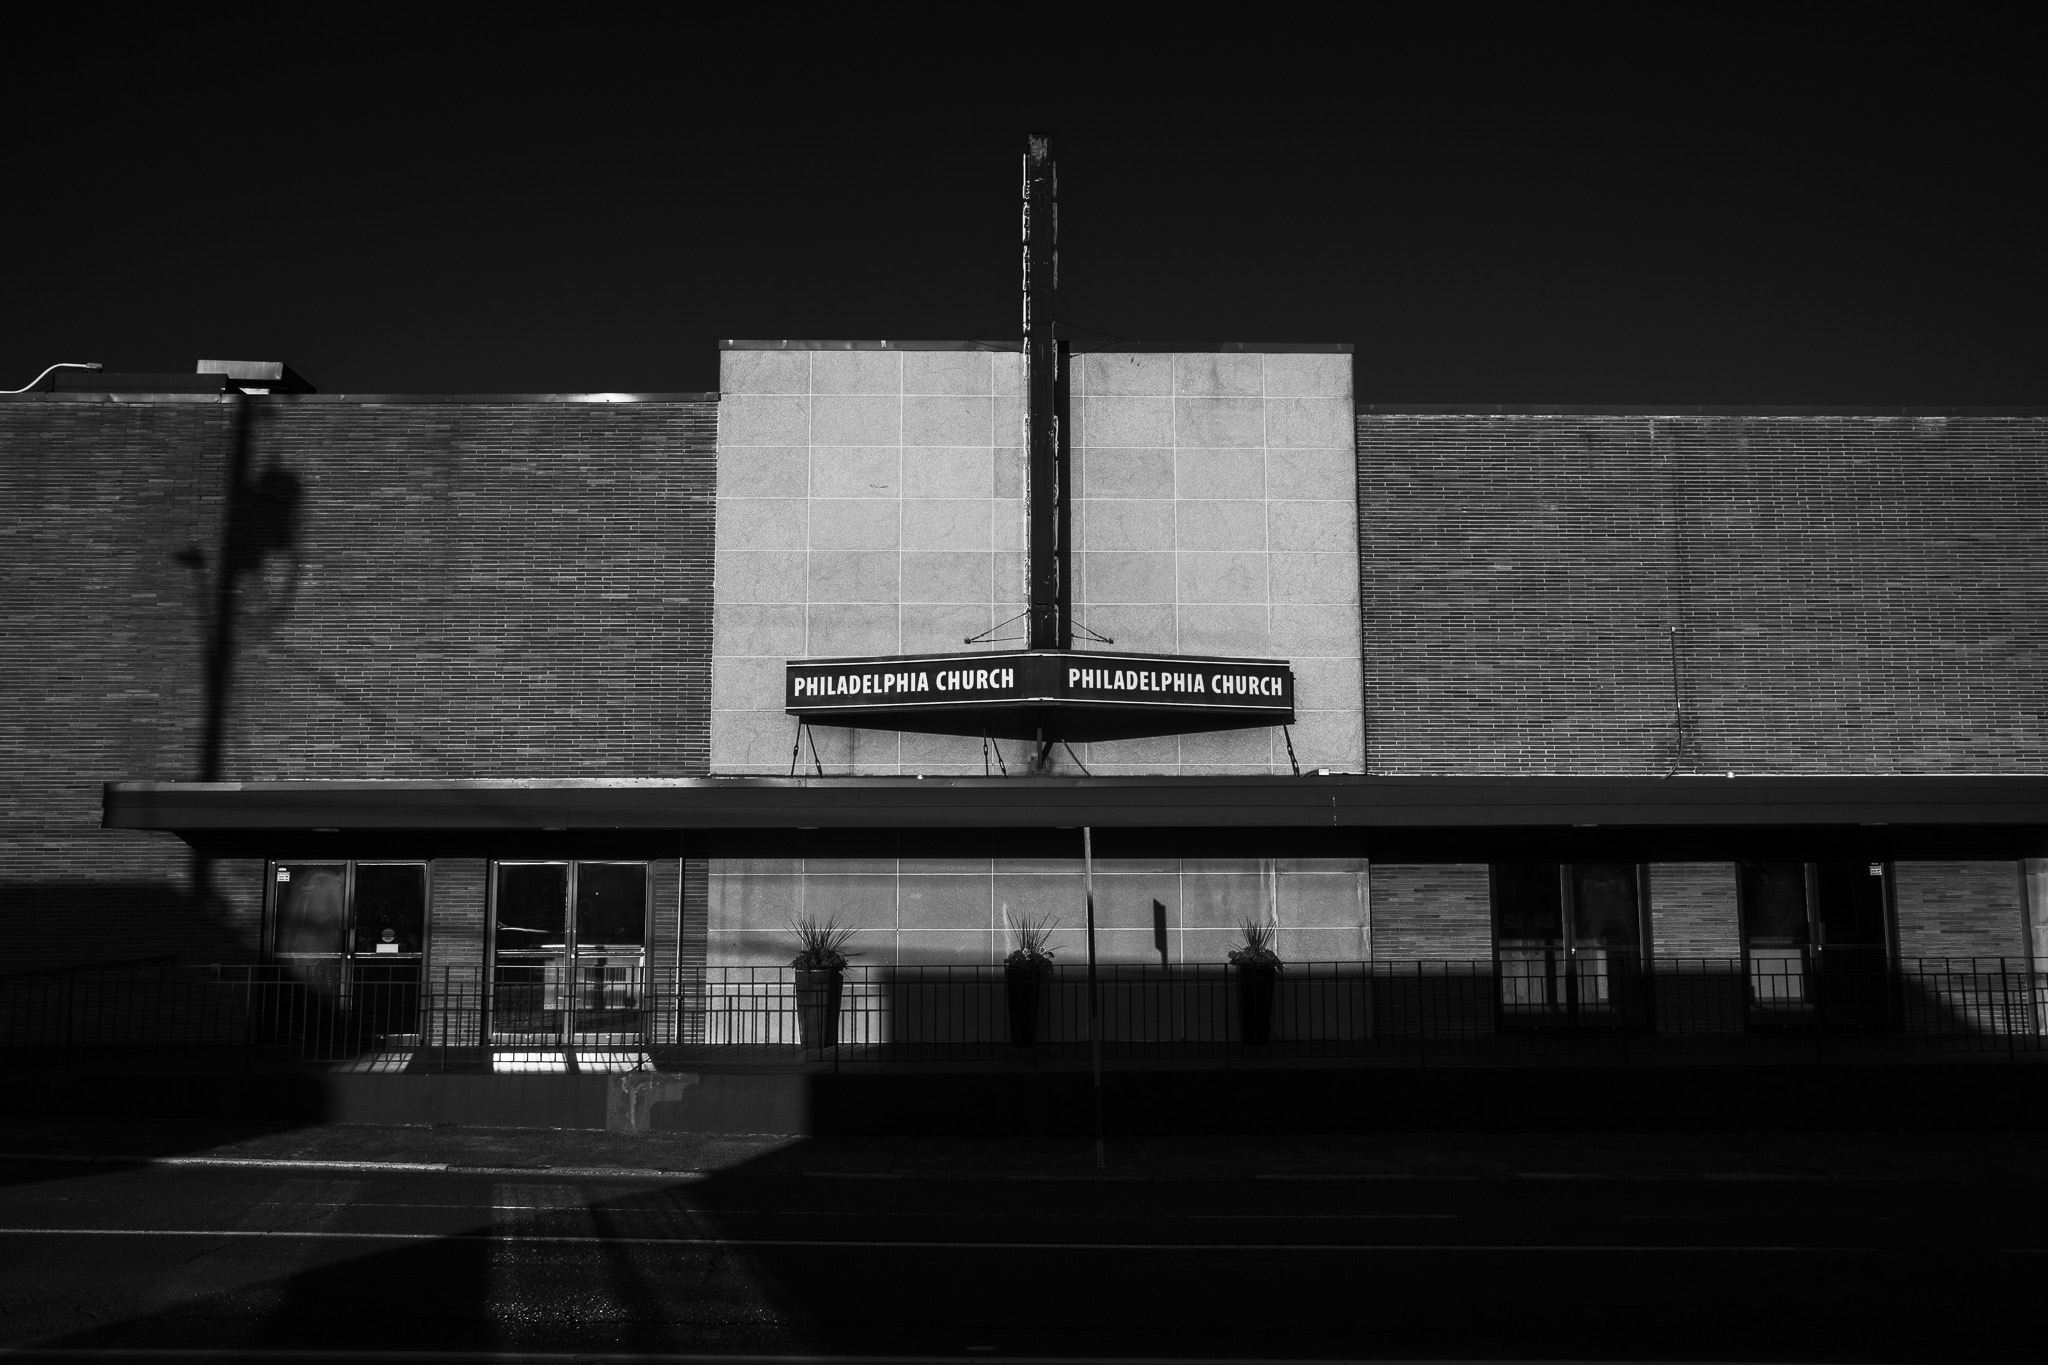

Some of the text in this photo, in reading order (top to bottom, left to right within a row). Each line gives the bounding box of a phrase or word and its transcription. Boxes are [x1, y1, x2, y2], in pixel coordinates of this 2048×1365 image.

[794, 668, 1014, 697] PHILADELPHIA CHURCH
[1068, 668, 1282, 697] PHILADELPHIA CHURCH
